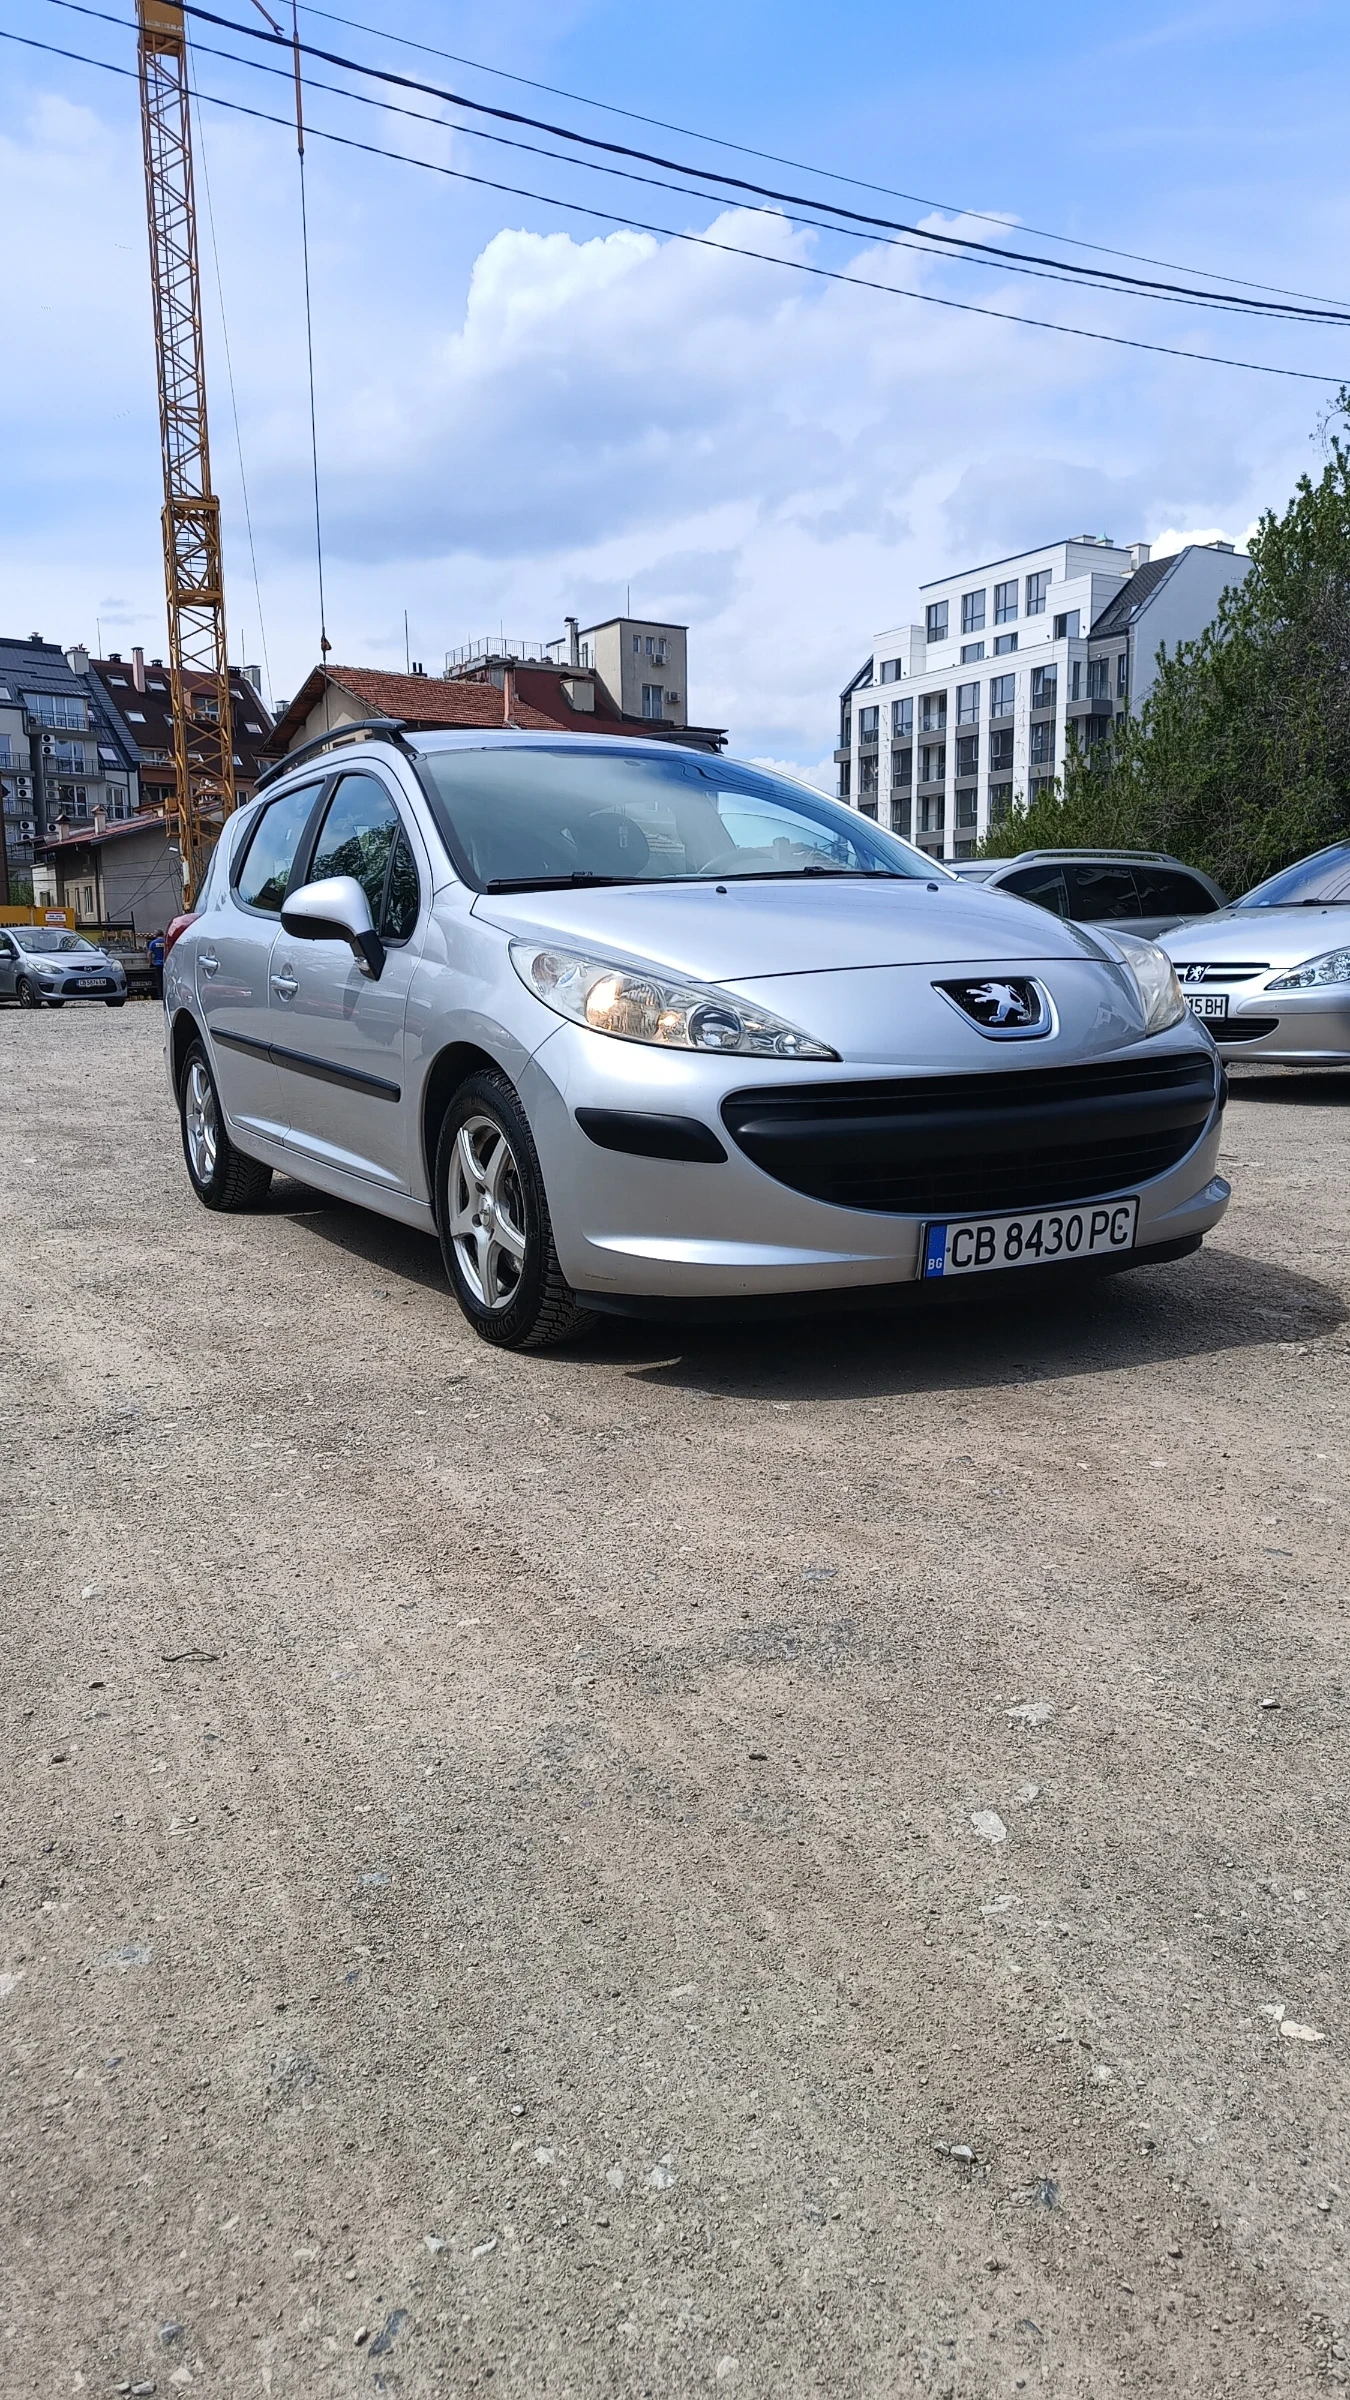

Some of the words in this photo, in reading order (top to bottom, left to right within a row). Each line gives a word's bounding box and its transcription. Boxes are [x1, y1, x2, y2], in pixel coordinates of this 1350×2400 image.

[1205, 998, 1223, 1015] BH
[951, 1226, 995, 1267] CB
[1004, 1214, 1083, 1260] 8430
[1089, 1207, 1130, 1249] PC
[928, 1258, 943, 1270] BG
